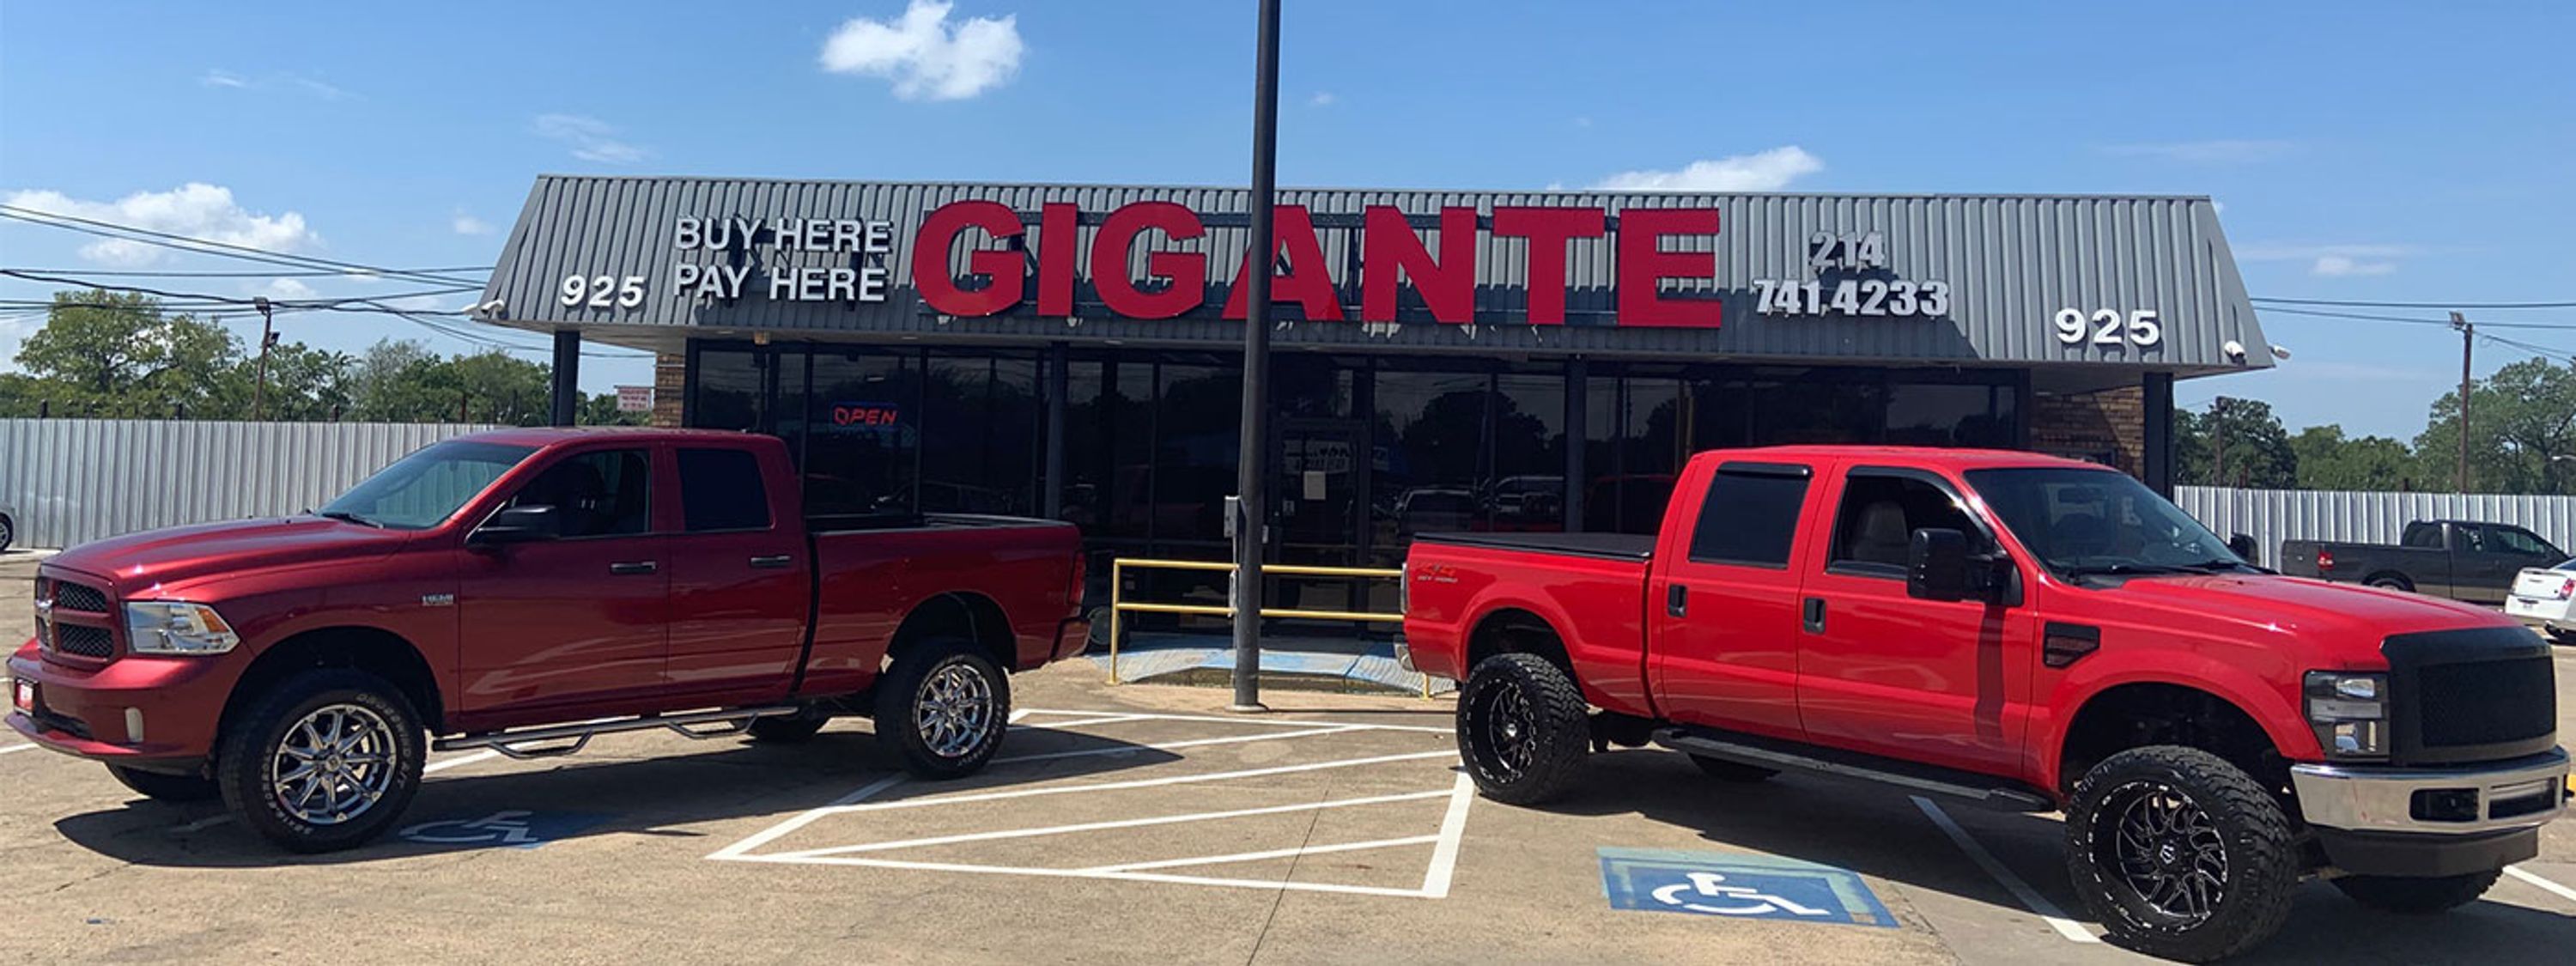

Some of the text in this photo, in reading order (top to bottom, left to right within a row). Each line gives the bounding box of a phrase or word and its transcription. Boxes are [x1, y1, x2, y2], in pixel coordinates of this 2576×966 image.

[674, 217, 892, 253] BUY HERE
[1811, 230, 1886, 268] 214
[673, 264, 887, 302] PAY HERE
[913, 199, 1722, 329] GIGANTE
[560, 274, 646, 308] 925
[2054, 307, 2160, 346] 925
[834, 406, 898, 426] OPEN
